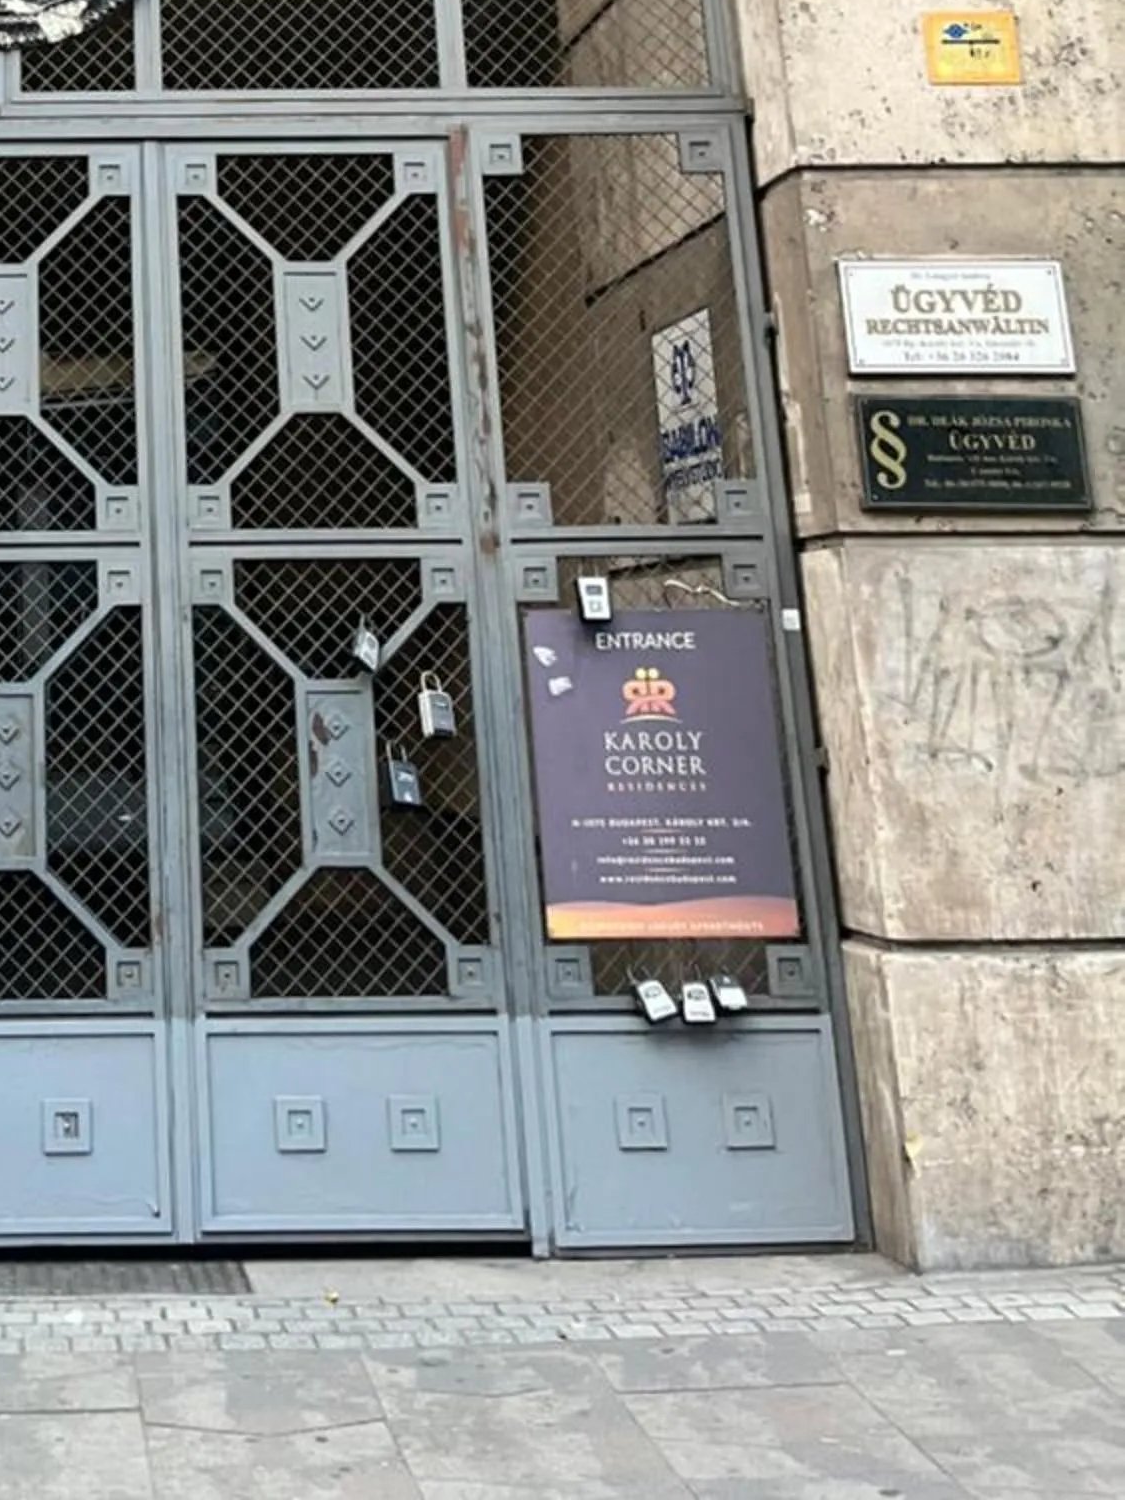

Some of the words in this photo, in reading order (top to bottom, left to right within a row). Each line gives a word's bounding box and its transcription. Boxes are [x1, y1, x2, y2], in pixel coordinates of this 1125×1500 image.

[890, 283, 1023, 314] ÜGYVÉD
[866, 316, 1050, 335] RECHTSANWÄLTIN
[948, 430, 1036, 451] ÜGYVÉD
[596, 632, 696, 650] ENTRANCE
[604, 731, 702, 751] KAROLY
[605, 755, 707, 775] CORNER
